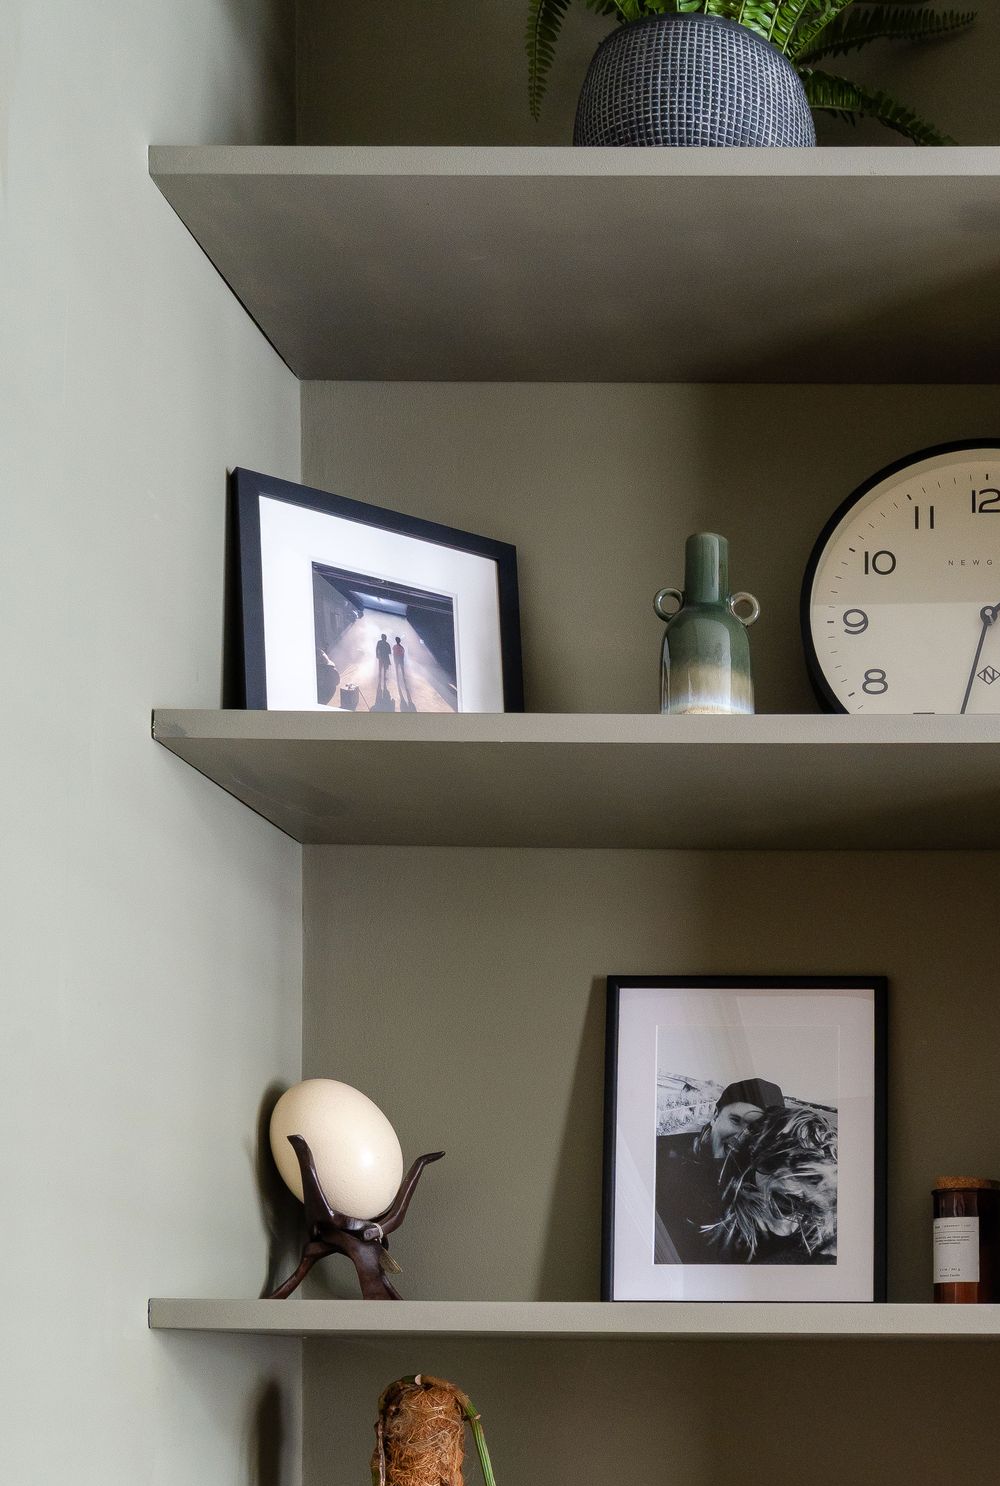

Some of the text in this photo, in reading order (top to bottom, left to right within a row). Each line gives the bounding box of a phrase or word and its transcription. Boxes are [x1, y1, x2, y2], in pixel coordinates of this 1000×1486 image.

[914, 505, 935, 530] 11
[864, 550, 897, 576] 10
[843, 608, 869, 635] 9
[861, 668, 889, 695] 8
